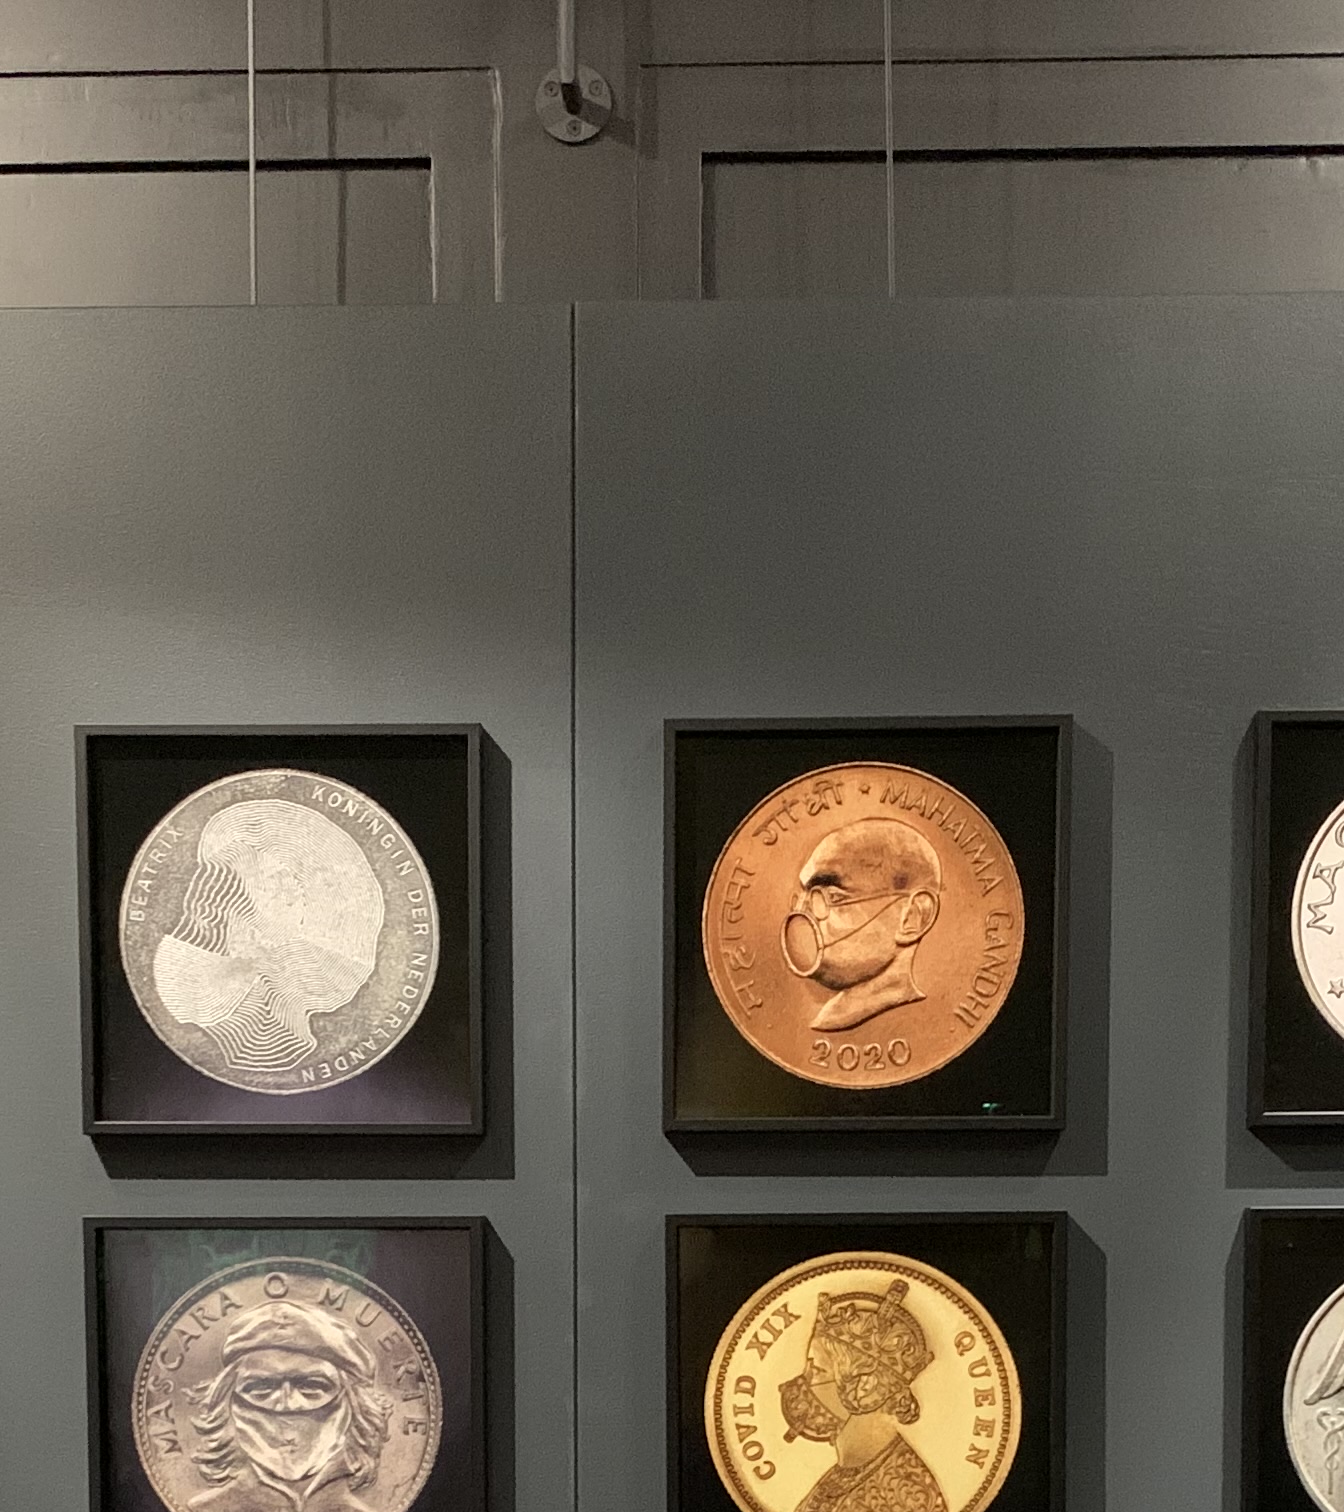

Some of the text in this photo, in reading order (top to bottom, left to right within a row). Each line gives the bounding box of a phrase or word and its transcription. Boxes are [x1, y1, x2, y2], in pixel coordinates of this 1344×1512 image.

[130, 826, 183, 922] BEATRIX
[301, 785, 430, 1084] KONINGIN DER NEDERLANDEN
[879, 779, 1014, 1030] MAHATMA GANDHI
[809, 1037, 912, 1071] 2020
[148, 1290, 243, 1456] MASCARA
[263, 1271, 289, 1299] O
[733, 1301, 802, 1482] COVID XIX
[953, 1330, 997, 1471] QUEEN
